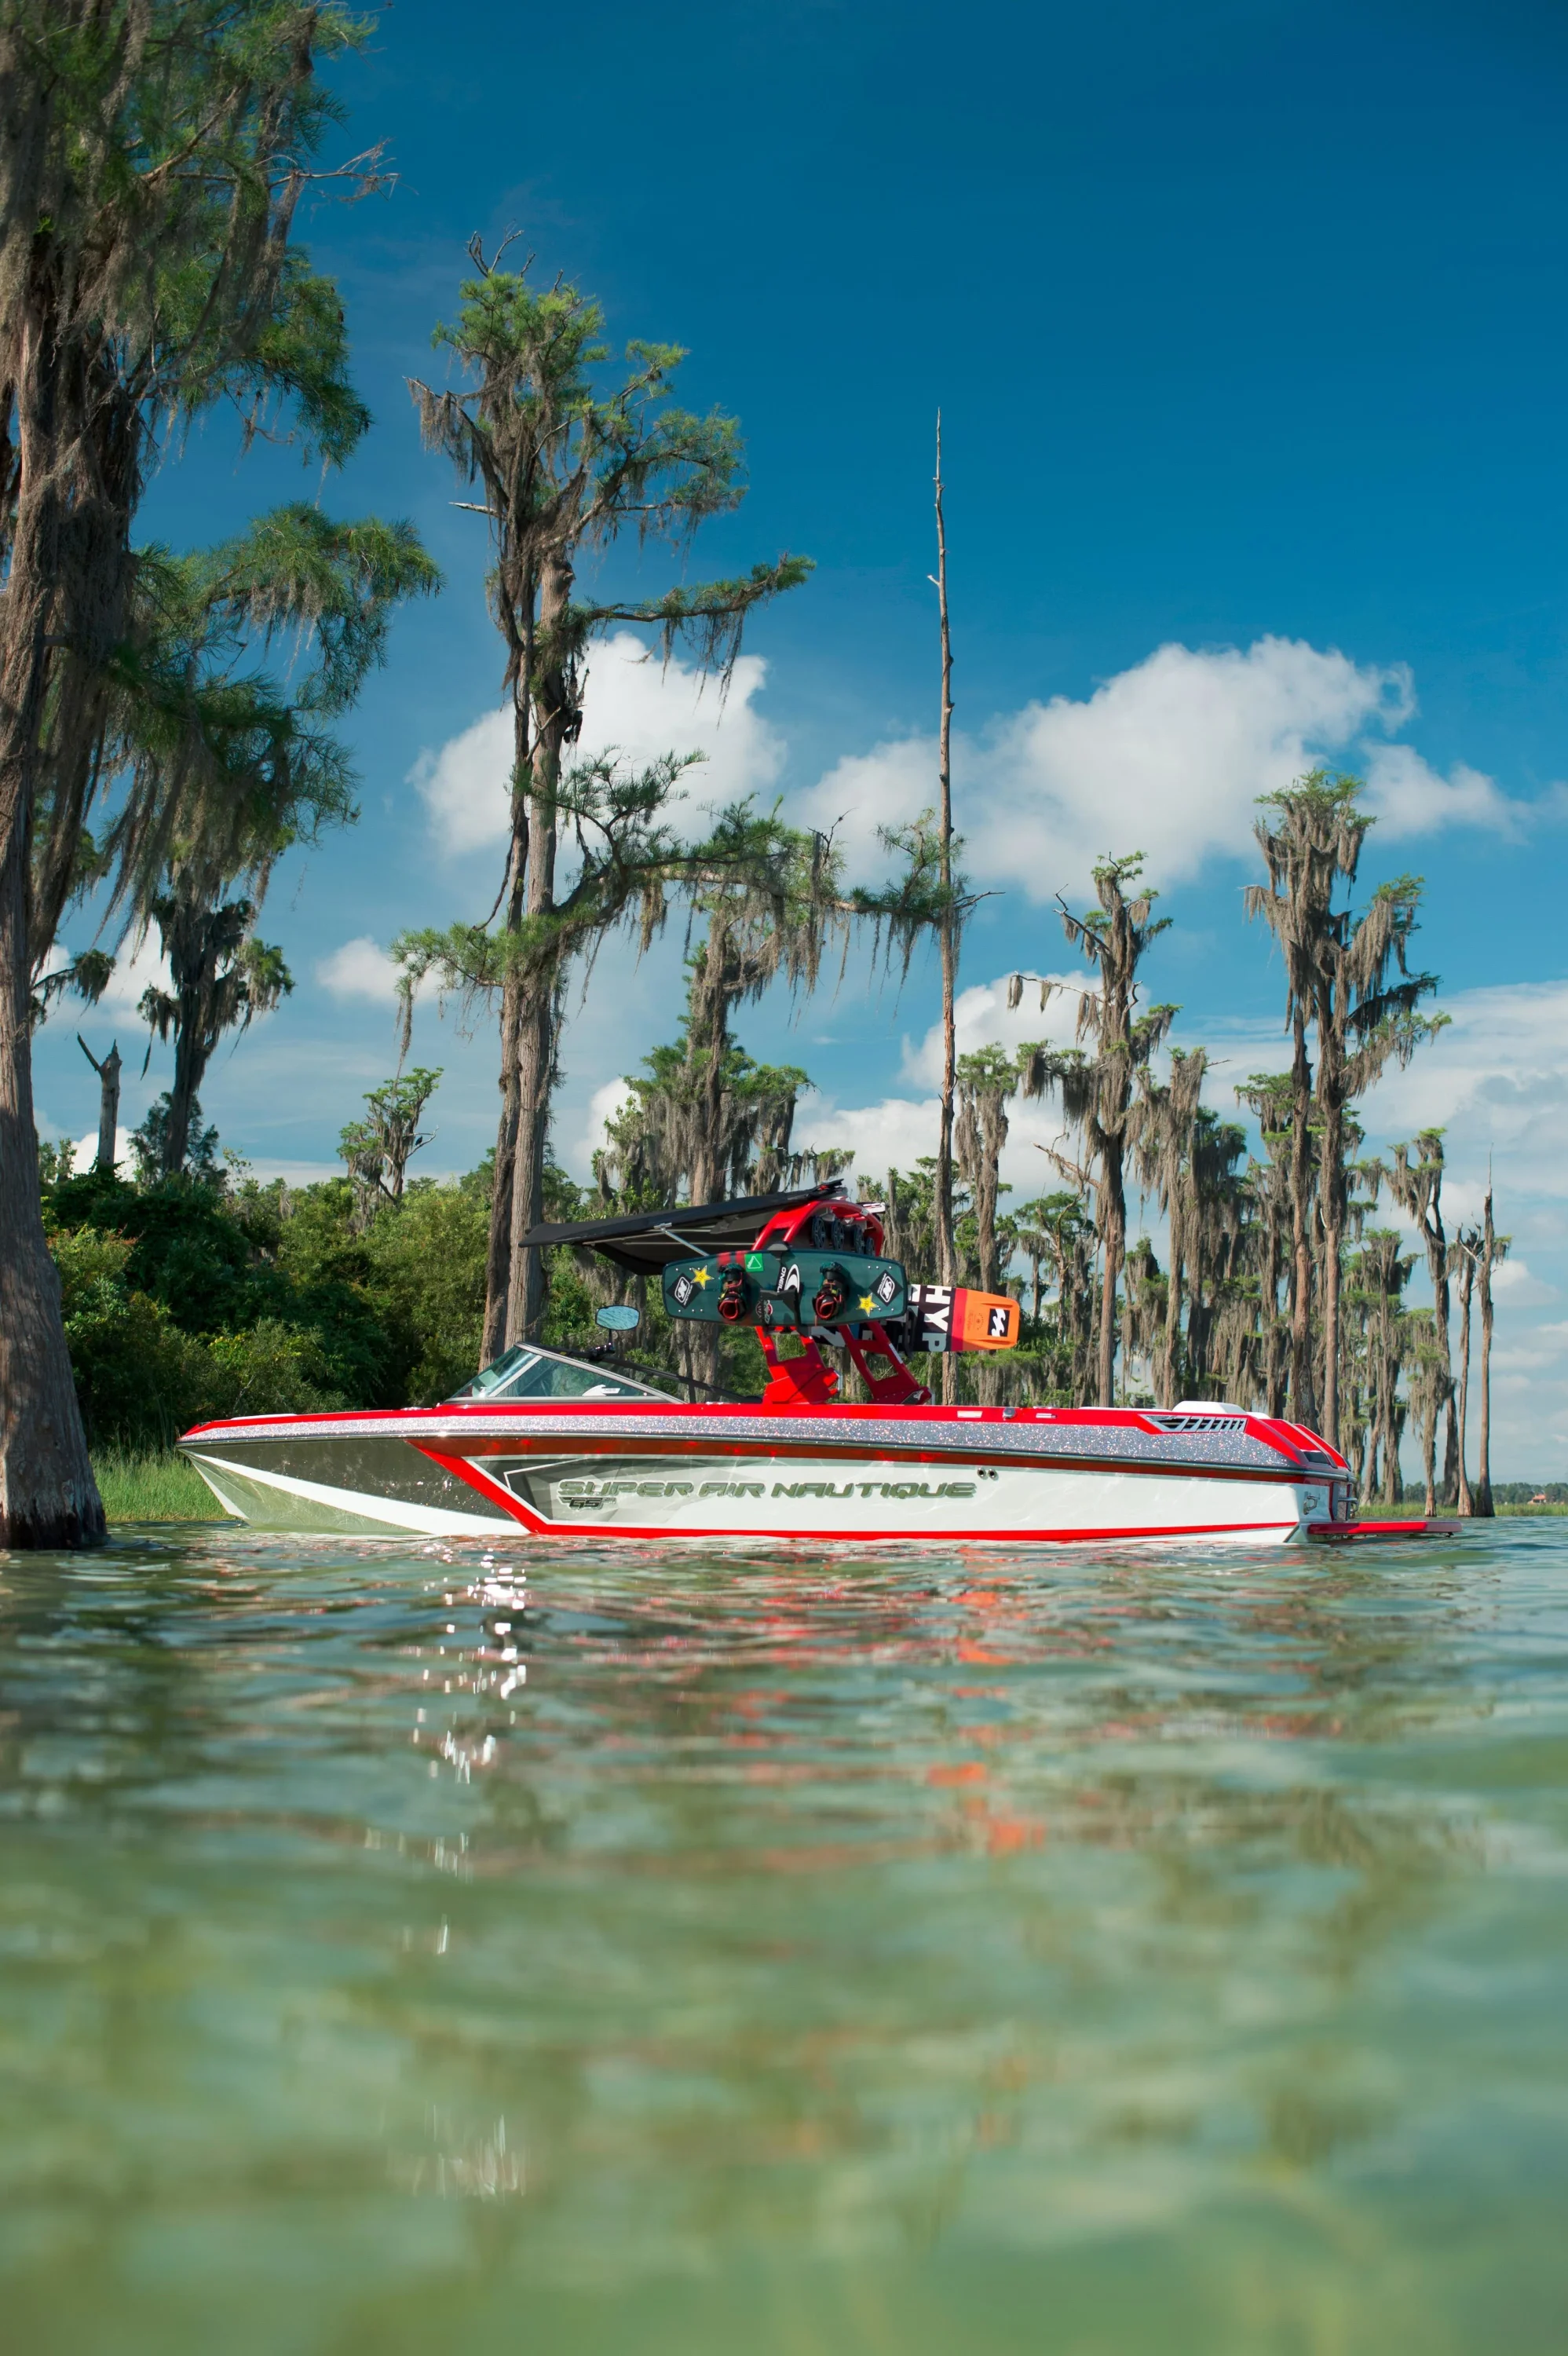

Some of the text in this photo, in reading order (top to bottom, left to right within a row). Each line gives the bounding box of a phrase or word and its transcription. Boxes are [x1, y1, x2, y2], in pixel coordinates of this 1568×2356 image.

[777, 1267, 787, 1293] ONEIL
[922, 1285, 952, 1352] HYP
[557, 1480, 978, 1500] SUPER AIR NAUTIQUE
